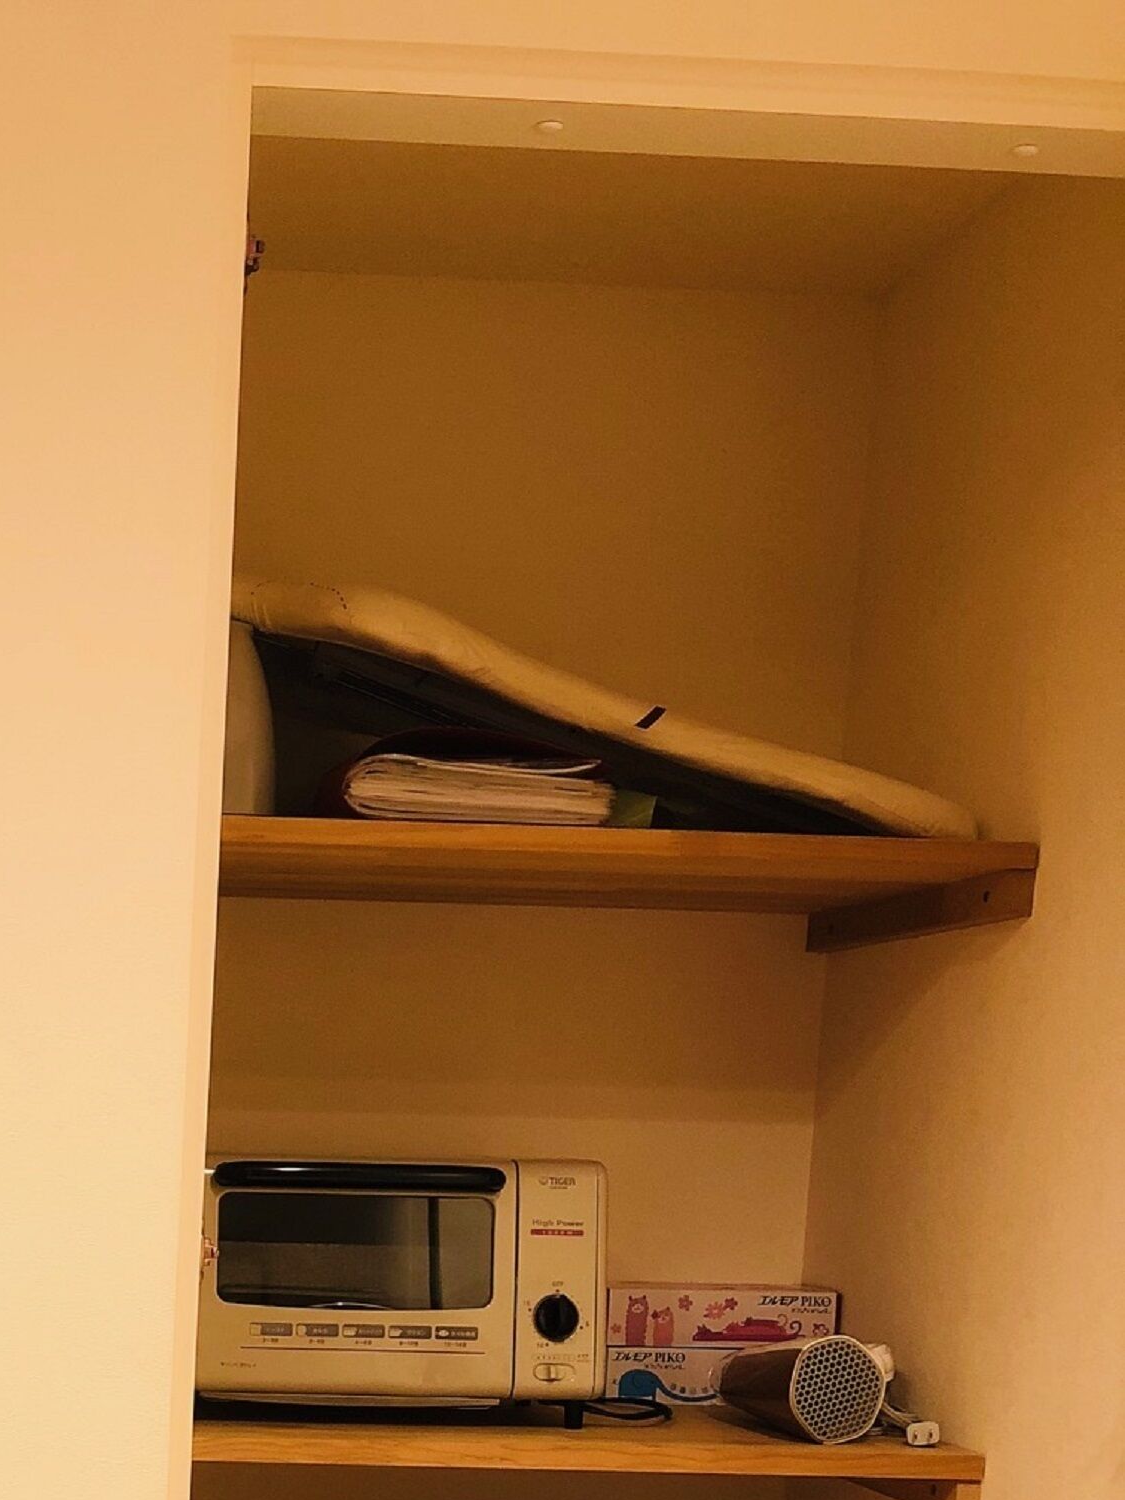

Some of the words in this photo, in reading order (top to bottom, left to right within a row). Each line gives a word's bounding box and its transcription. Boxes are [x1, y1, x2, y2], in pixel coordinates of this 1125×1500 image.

[556, 1219, 584, 1227] Power
[800, 1296, 832, 1308] PIKO
[654, 1352, 686, 1364] PIKO
